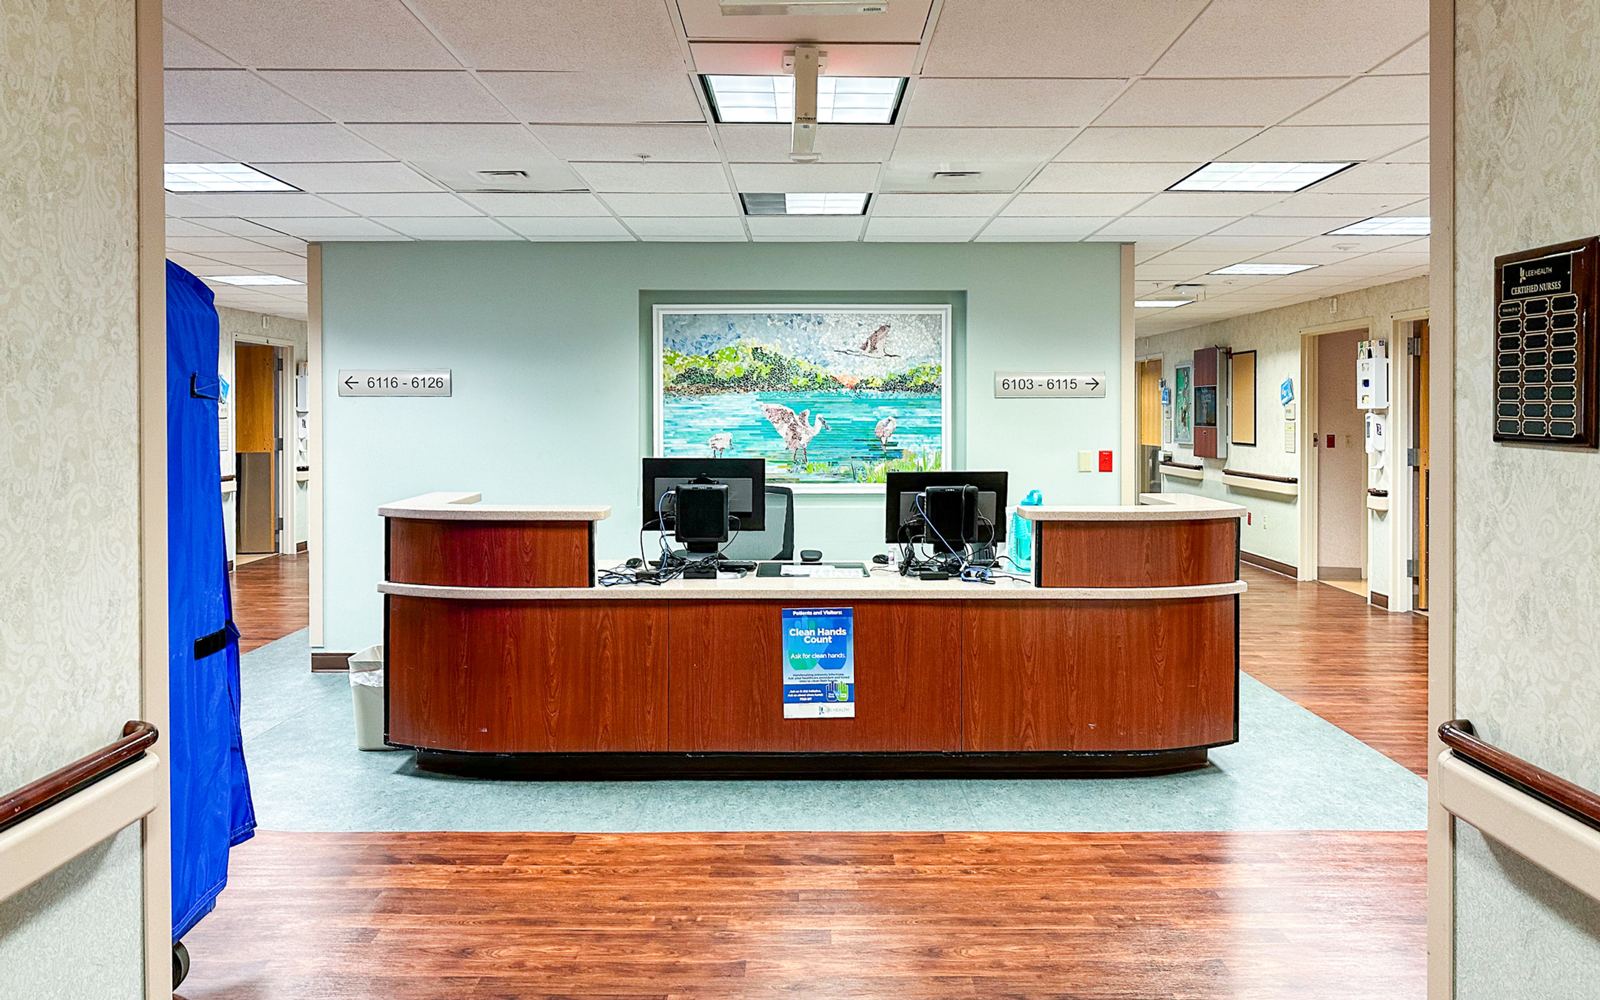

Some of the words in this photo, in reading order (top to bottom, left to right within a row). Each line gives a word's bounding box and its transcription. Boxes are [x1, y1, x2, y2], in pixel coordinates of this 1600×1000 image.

[1533, 267, 1552, 276] HEALTH
[1511, 284, 1538, 295] CERTIFIED
[1539, 280, 1562, 291] NURSES
[367, 376, 398, 389] 6116
[411, 376, 444, 389] 6126
[1002, 378, 1034, 390] 6103
[1046, 378, 1078, 390] 6115
[789, 628, 816, 636] Clean
[817, 627, 847, 636] Hands
[803, 636, 833, 644] Count
